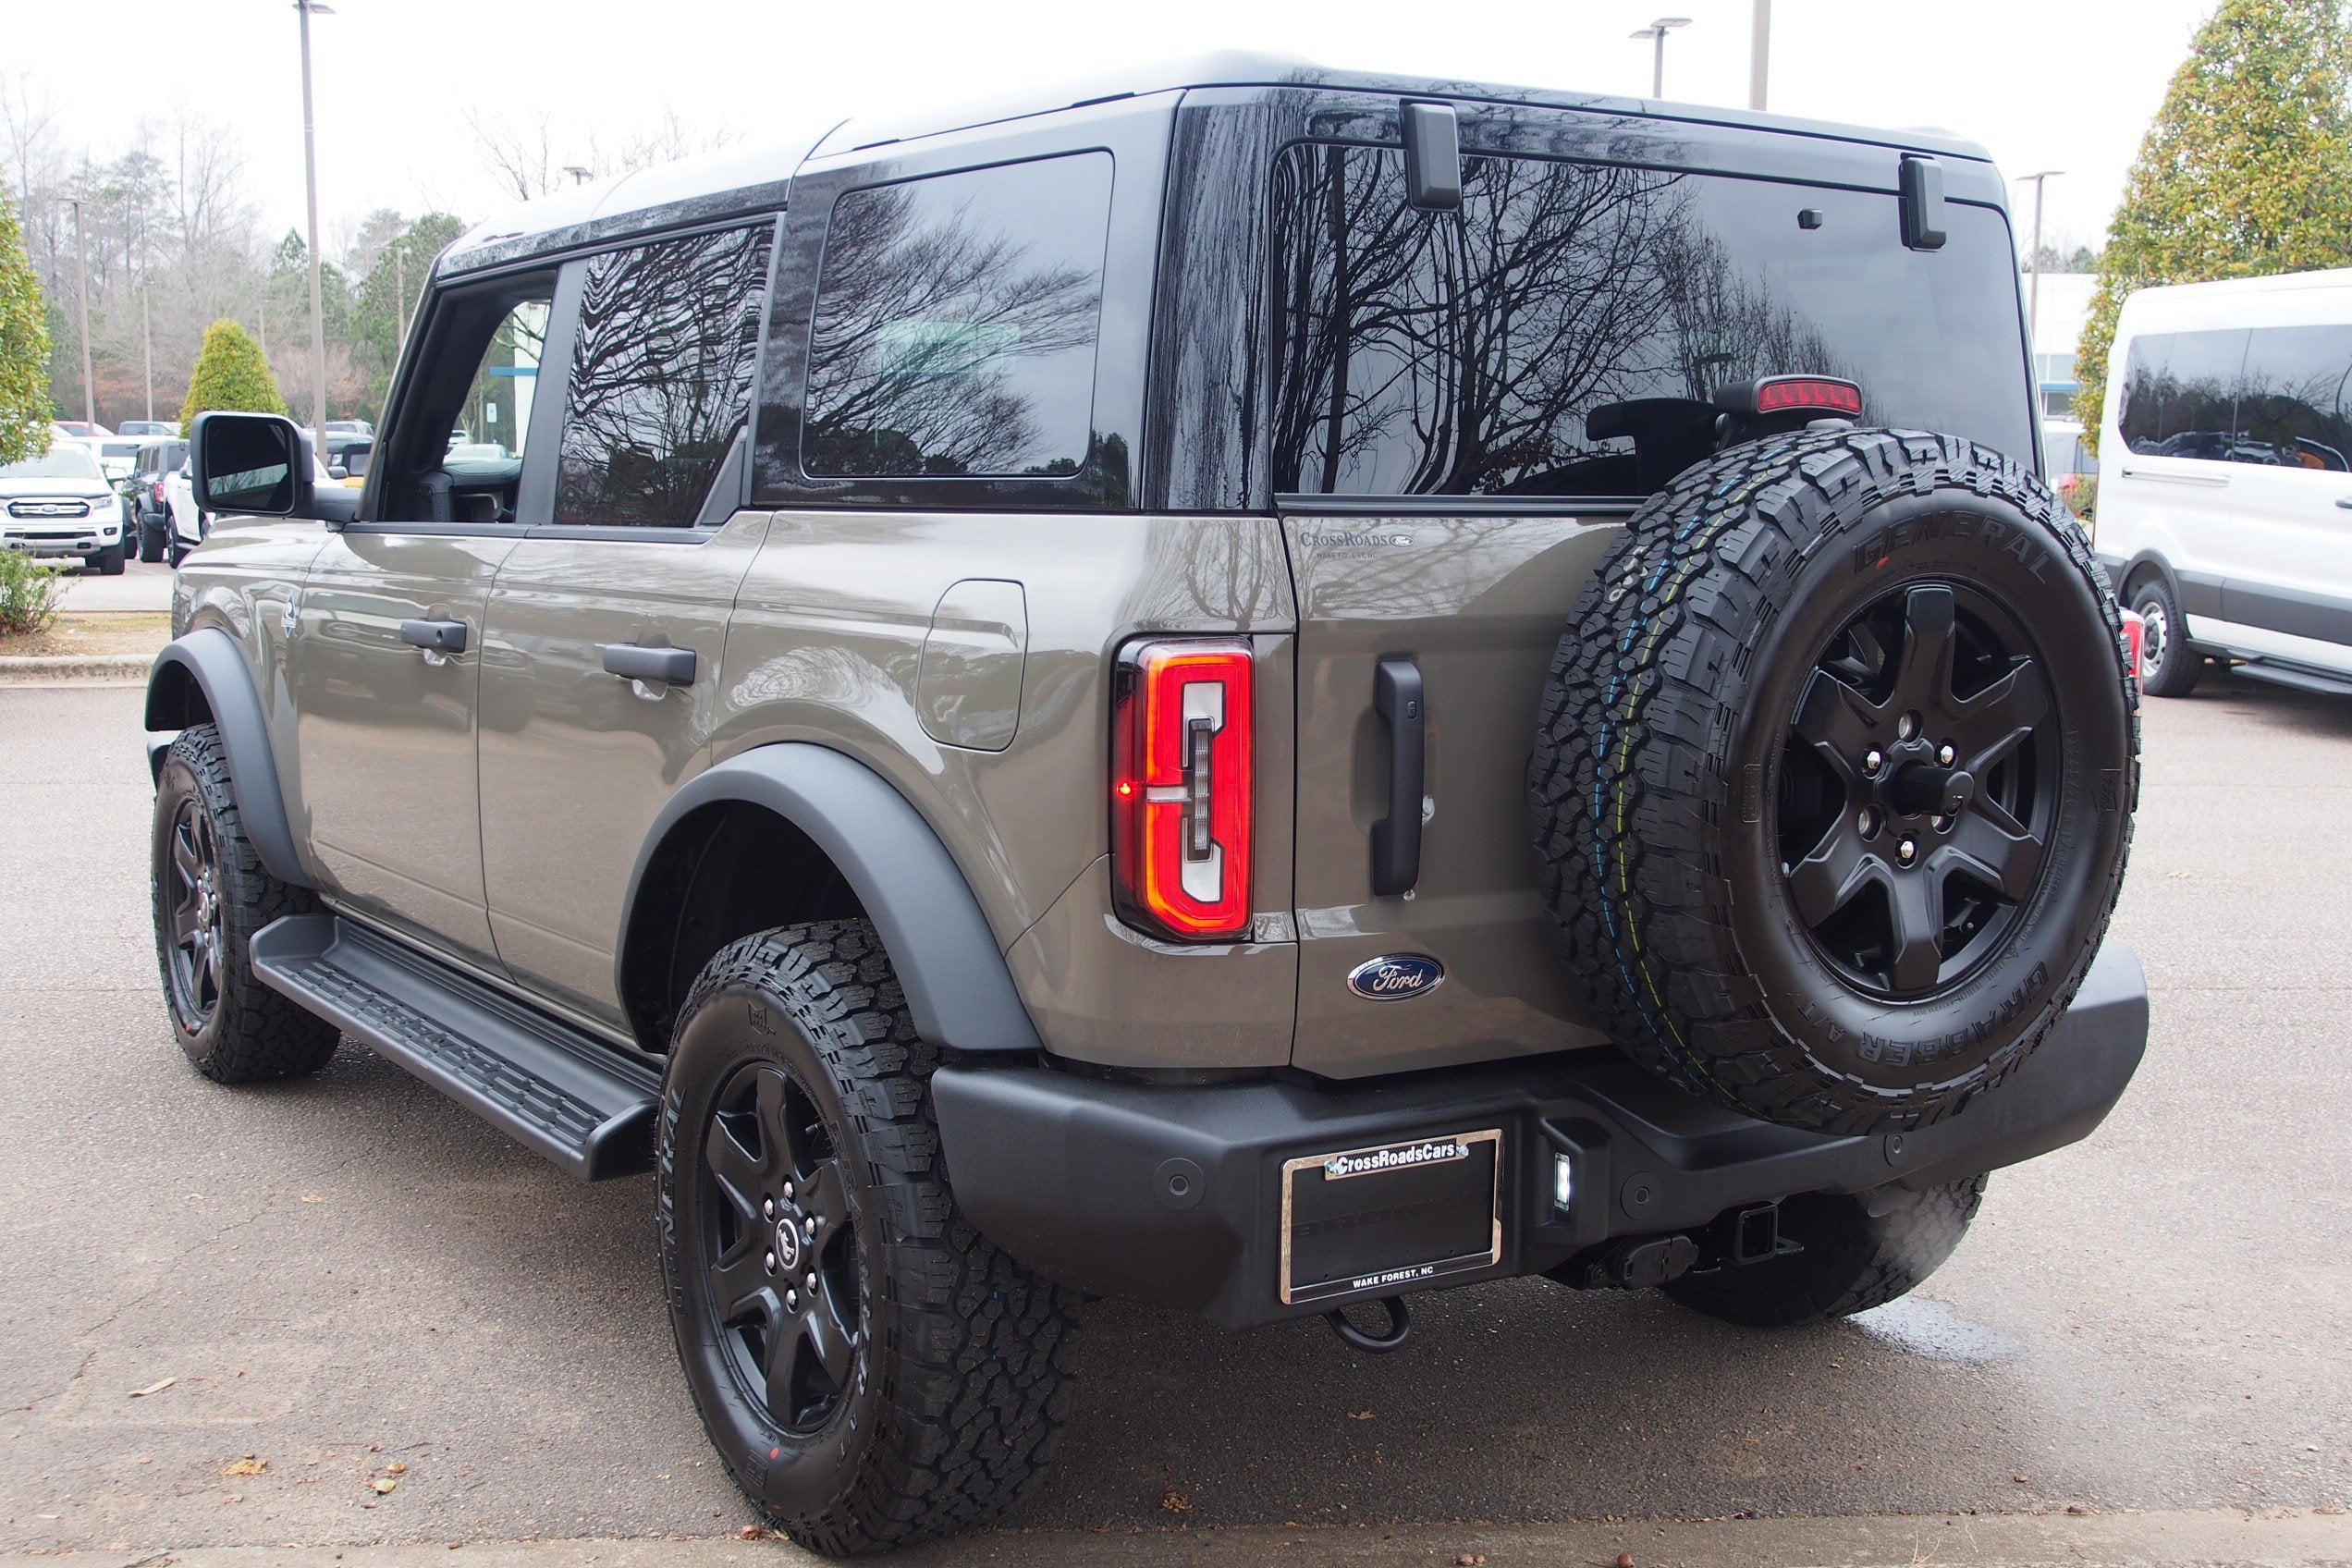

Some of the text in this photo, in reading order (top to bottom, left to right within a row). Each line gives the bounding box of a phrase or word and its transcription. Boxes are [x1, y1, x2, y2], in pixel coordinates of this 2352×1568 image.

[1853, 510, 2048, 584] GENERAL
[1372, 963, 1424, 992] Ford
[1856, 960, 2049, 1067] GRABBER
[1337, 1144, 1456, 1175] CrossRoadsCars
[1353, 1266, 1434, 1289] WAKE FOREST, NC
